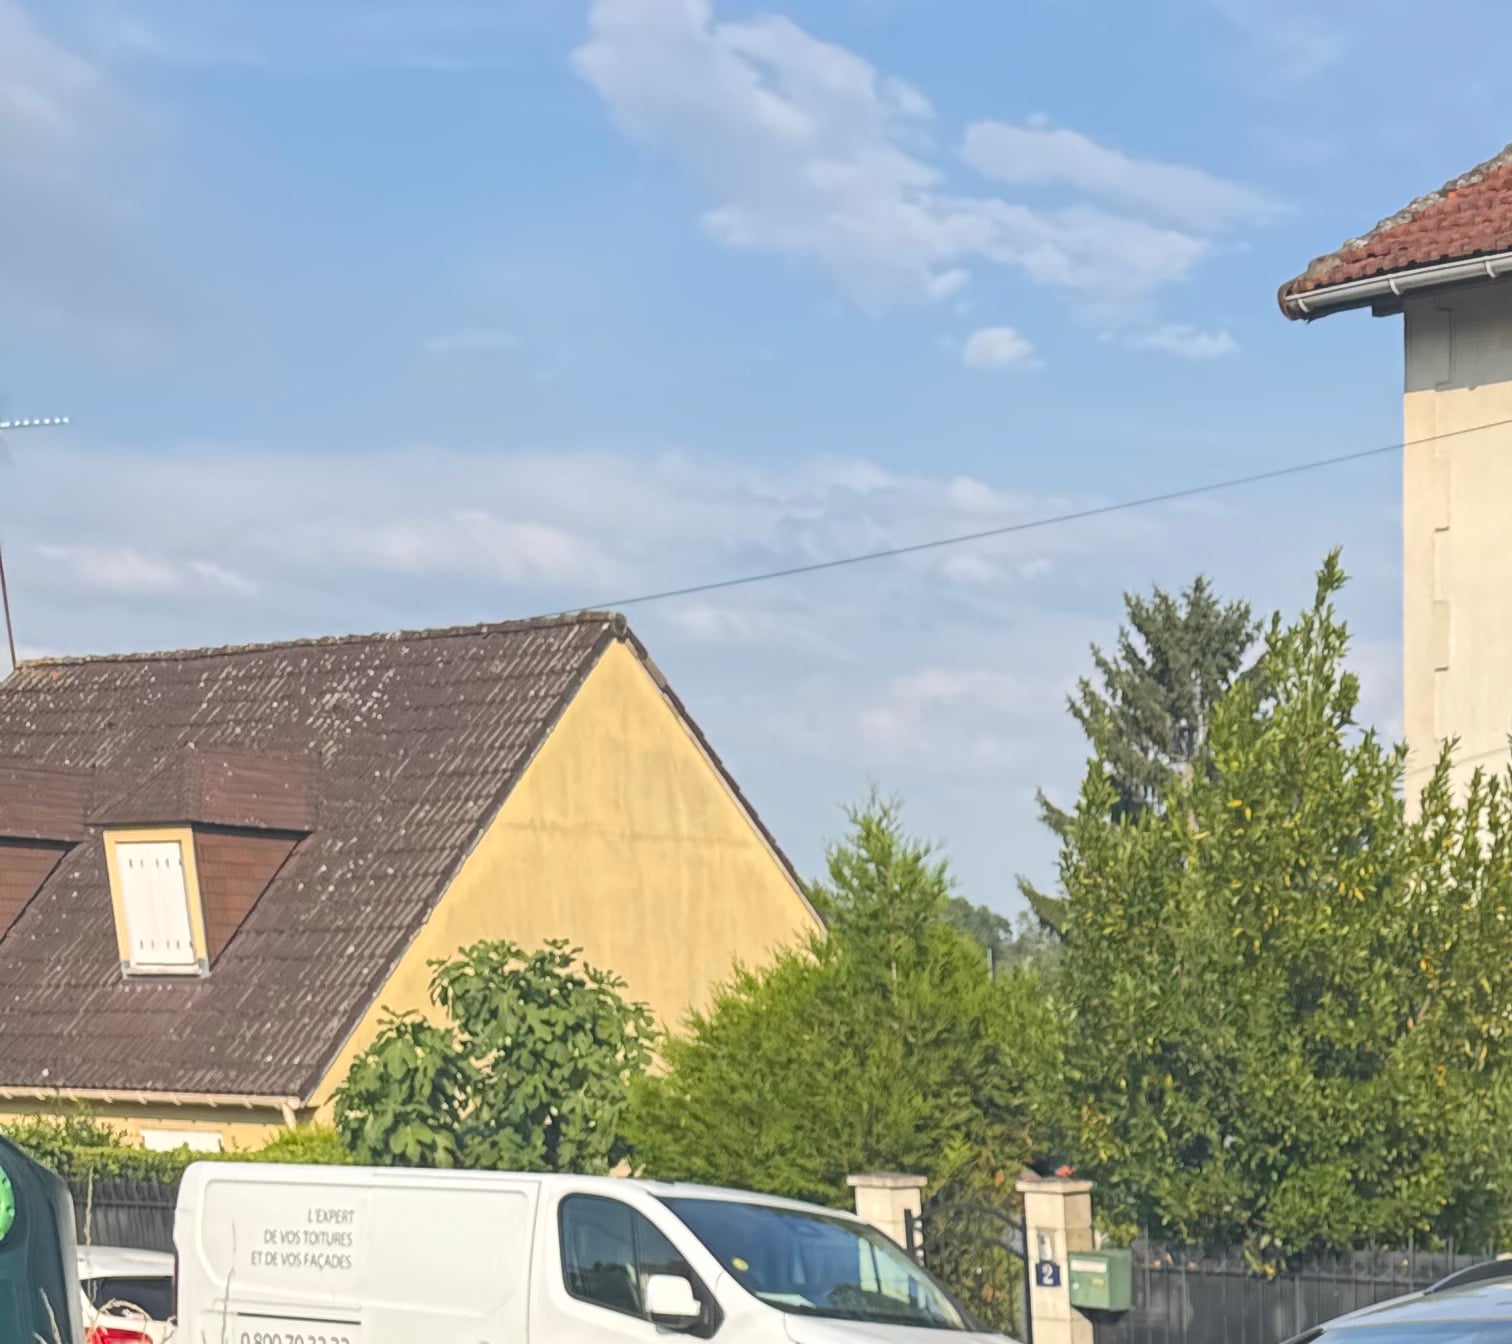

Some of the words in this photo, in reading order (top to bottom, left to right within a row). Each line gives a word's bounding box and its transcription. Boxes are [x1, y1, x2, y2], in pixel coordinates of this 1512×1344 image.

[307, 1208, 354, 1224] L'EXPERT
[264, 1229, 278, 1244] DE
[280, 1230, 300, 1245] VOS
[303, 1231, 352, 1247] TOITURES
[251, 1250, 262, 1266] ET
[265, 1251, 278, 1267] DE
[281, 1252, 301, 1268] VOS
[303, 1252, 352, 1272] FAÇADES
[1042, 1263, 1054, 1285] 2
